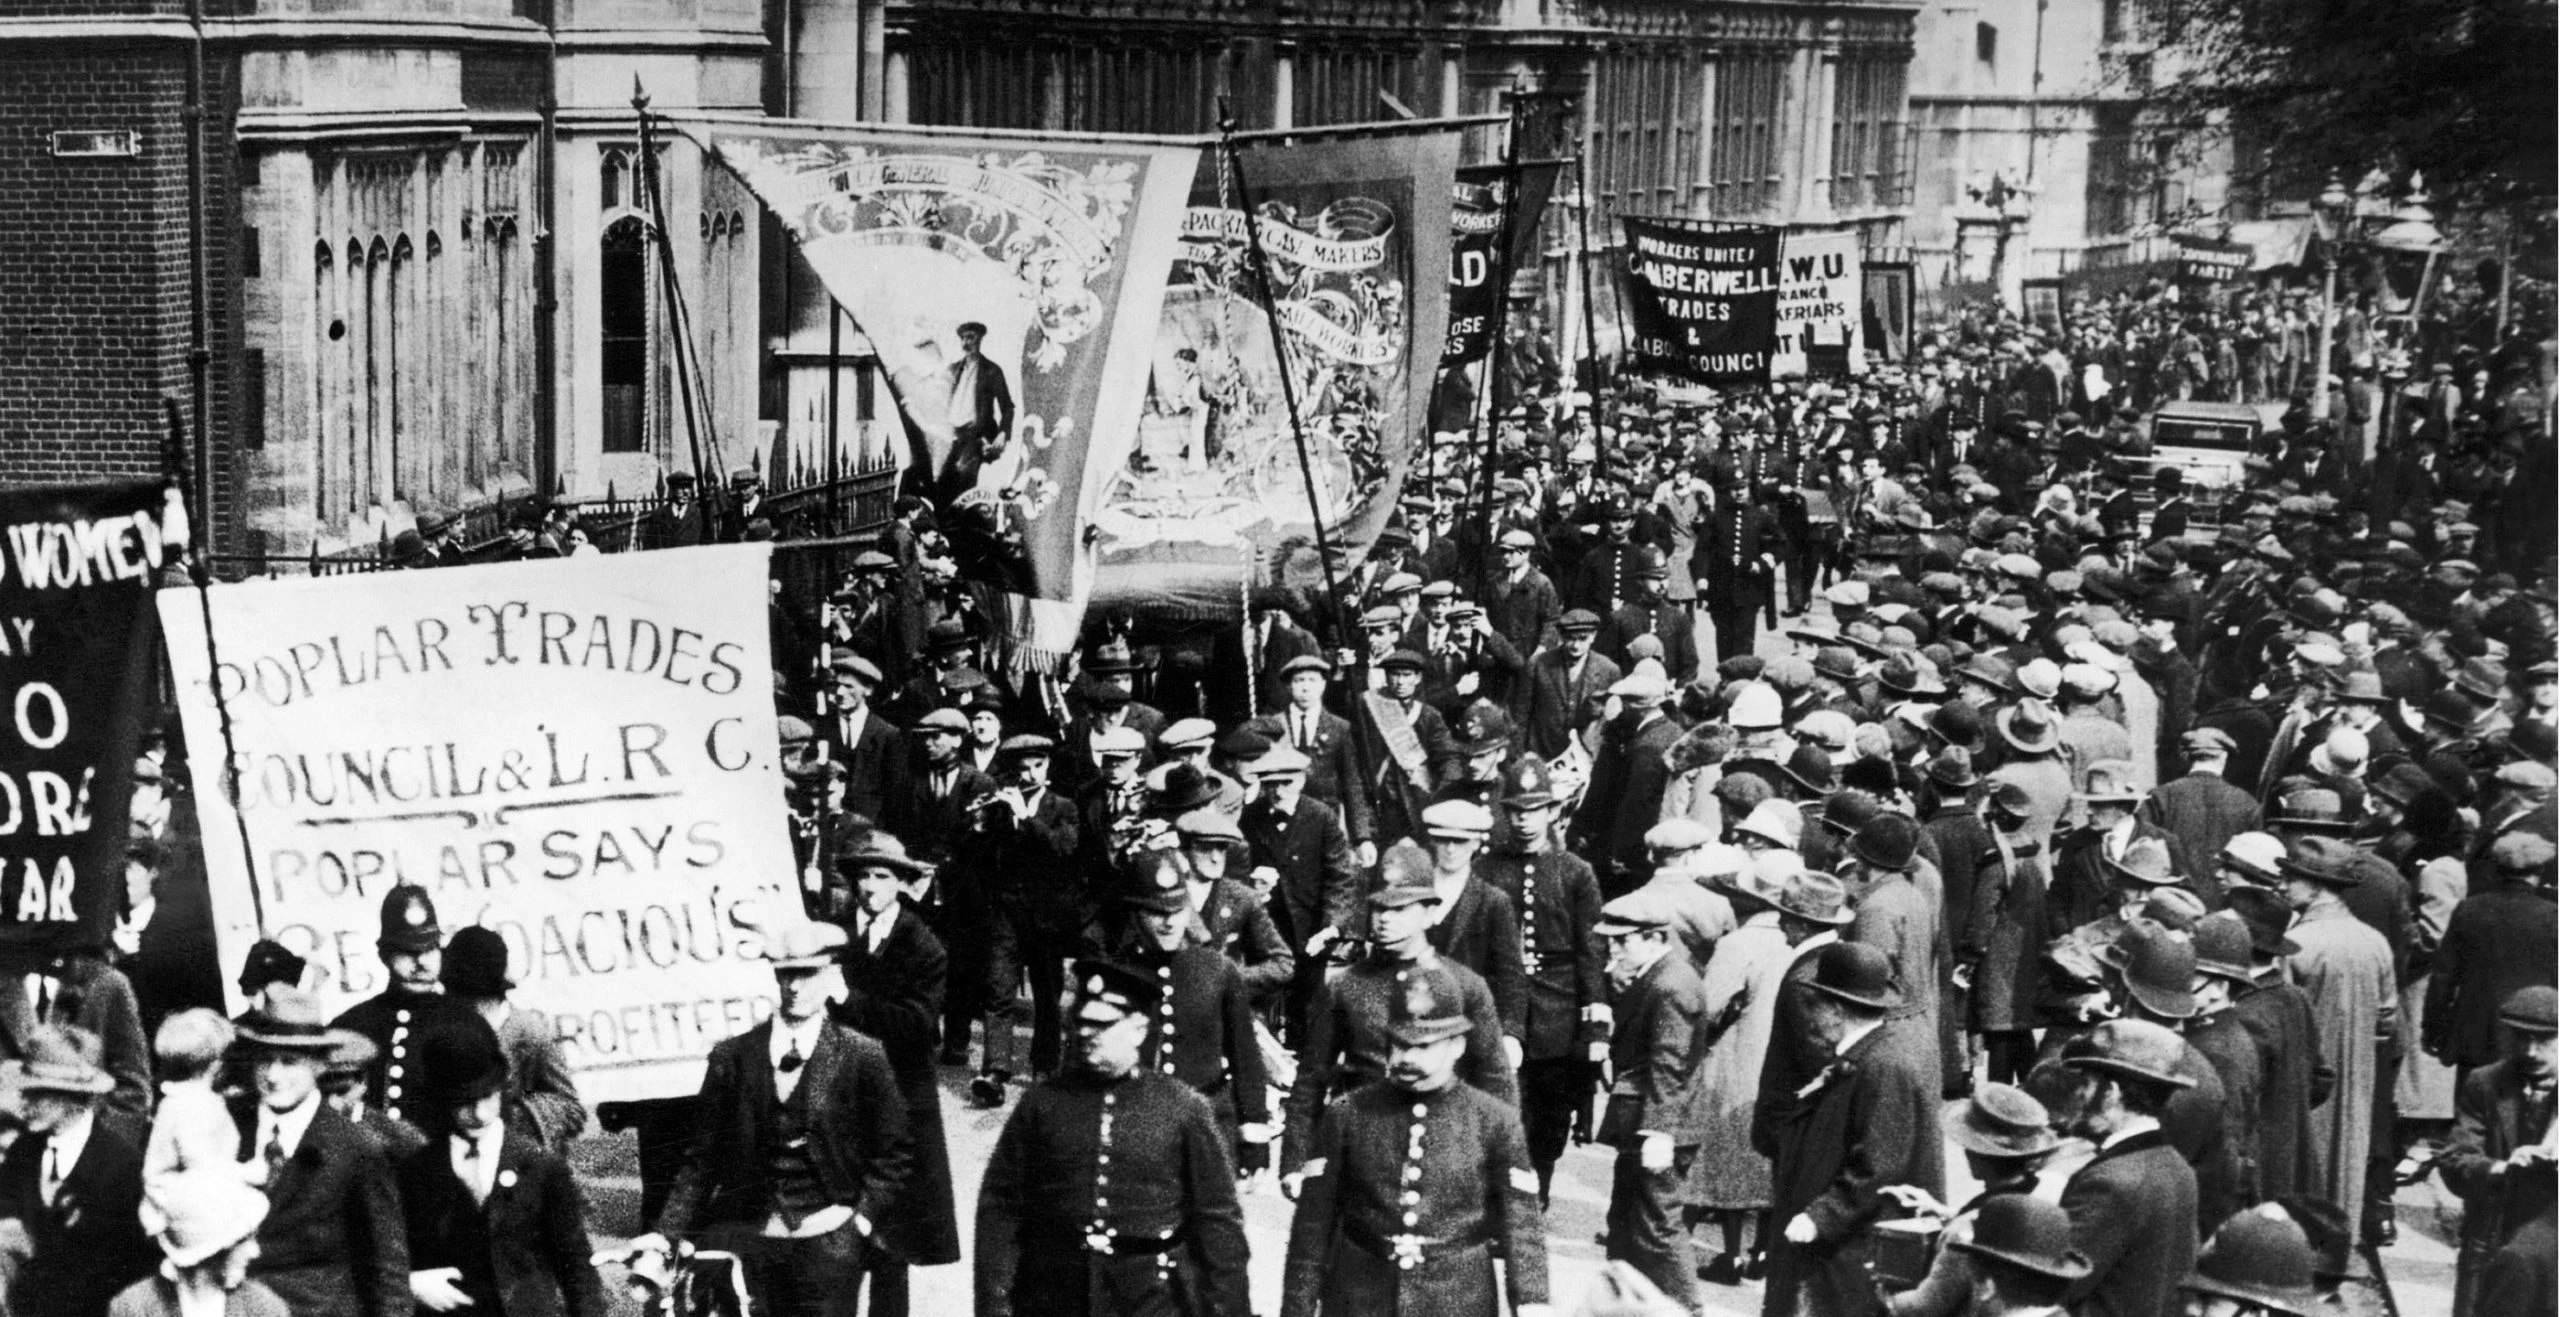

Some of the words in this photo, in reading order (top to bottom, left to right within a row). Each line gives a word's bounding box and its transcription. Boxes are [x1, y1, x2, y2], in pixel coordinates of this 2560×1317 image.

[1314, 241, 1383, 264] MAKERS
[1638, 235, 1700, 261] WORKERS
[2189, 263, 2235, 280] PARTY
[1658, 296, 1731, 321] TRADES
[193, 617, 453, 707] POPLAR
[466, 601, 744, 696] TRADES
[217, 742, 486, 812] COUNCIL
[496, 749, 532, 793] &
[541, 820, 726, 881] SAYS
[0, 855, 78, 922] AR
